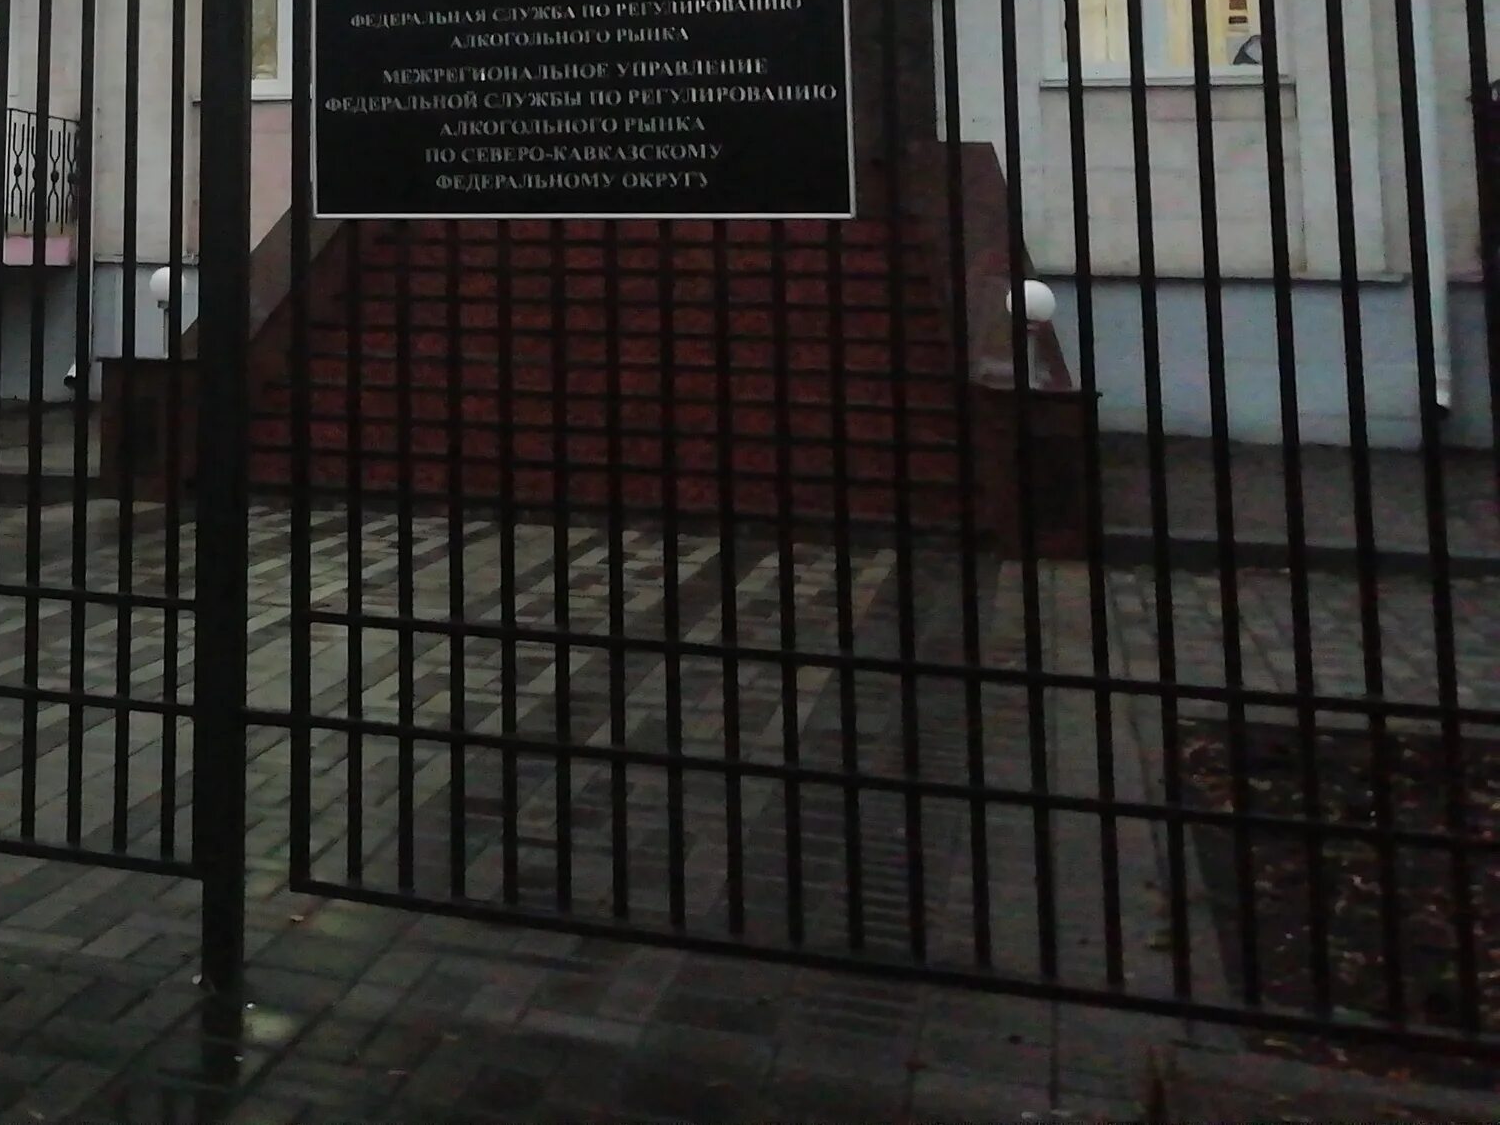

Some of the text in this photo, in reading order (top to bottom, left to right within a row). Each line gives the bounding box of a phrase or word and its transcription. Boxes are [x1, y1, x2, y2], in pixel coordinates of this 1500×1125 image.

[350, 9, 486, 28] ФЕДЕРАЛЬНАЯ
[492, 5, 575, 22] СЛУЖБА
[582, 3, 611, 19] ПО
[450, 26, 689, 49] АЛКОГОЛЬНОГО РЫНКА
[383, 58, 768, 84] МЕЖРЕГИОНАЛЬНОЕ УПРАВЛЕНИЕ
[325, 84, 837, 114] ФЕДЕРАЛЬНОЙ СЛУЖБЫ ПО РЕГУЛИРОВАНИЮ
[440, 116, 706, 137] АЛКОГОЛЬНОГО РЫНКА
[425, 143, 723, 163] ПО СЕВЕРО-КАВКАЗСКОМУ
[435, 171, 709, 192] ФЕДЕРАЛЬНОМУ ОКРУГУ
